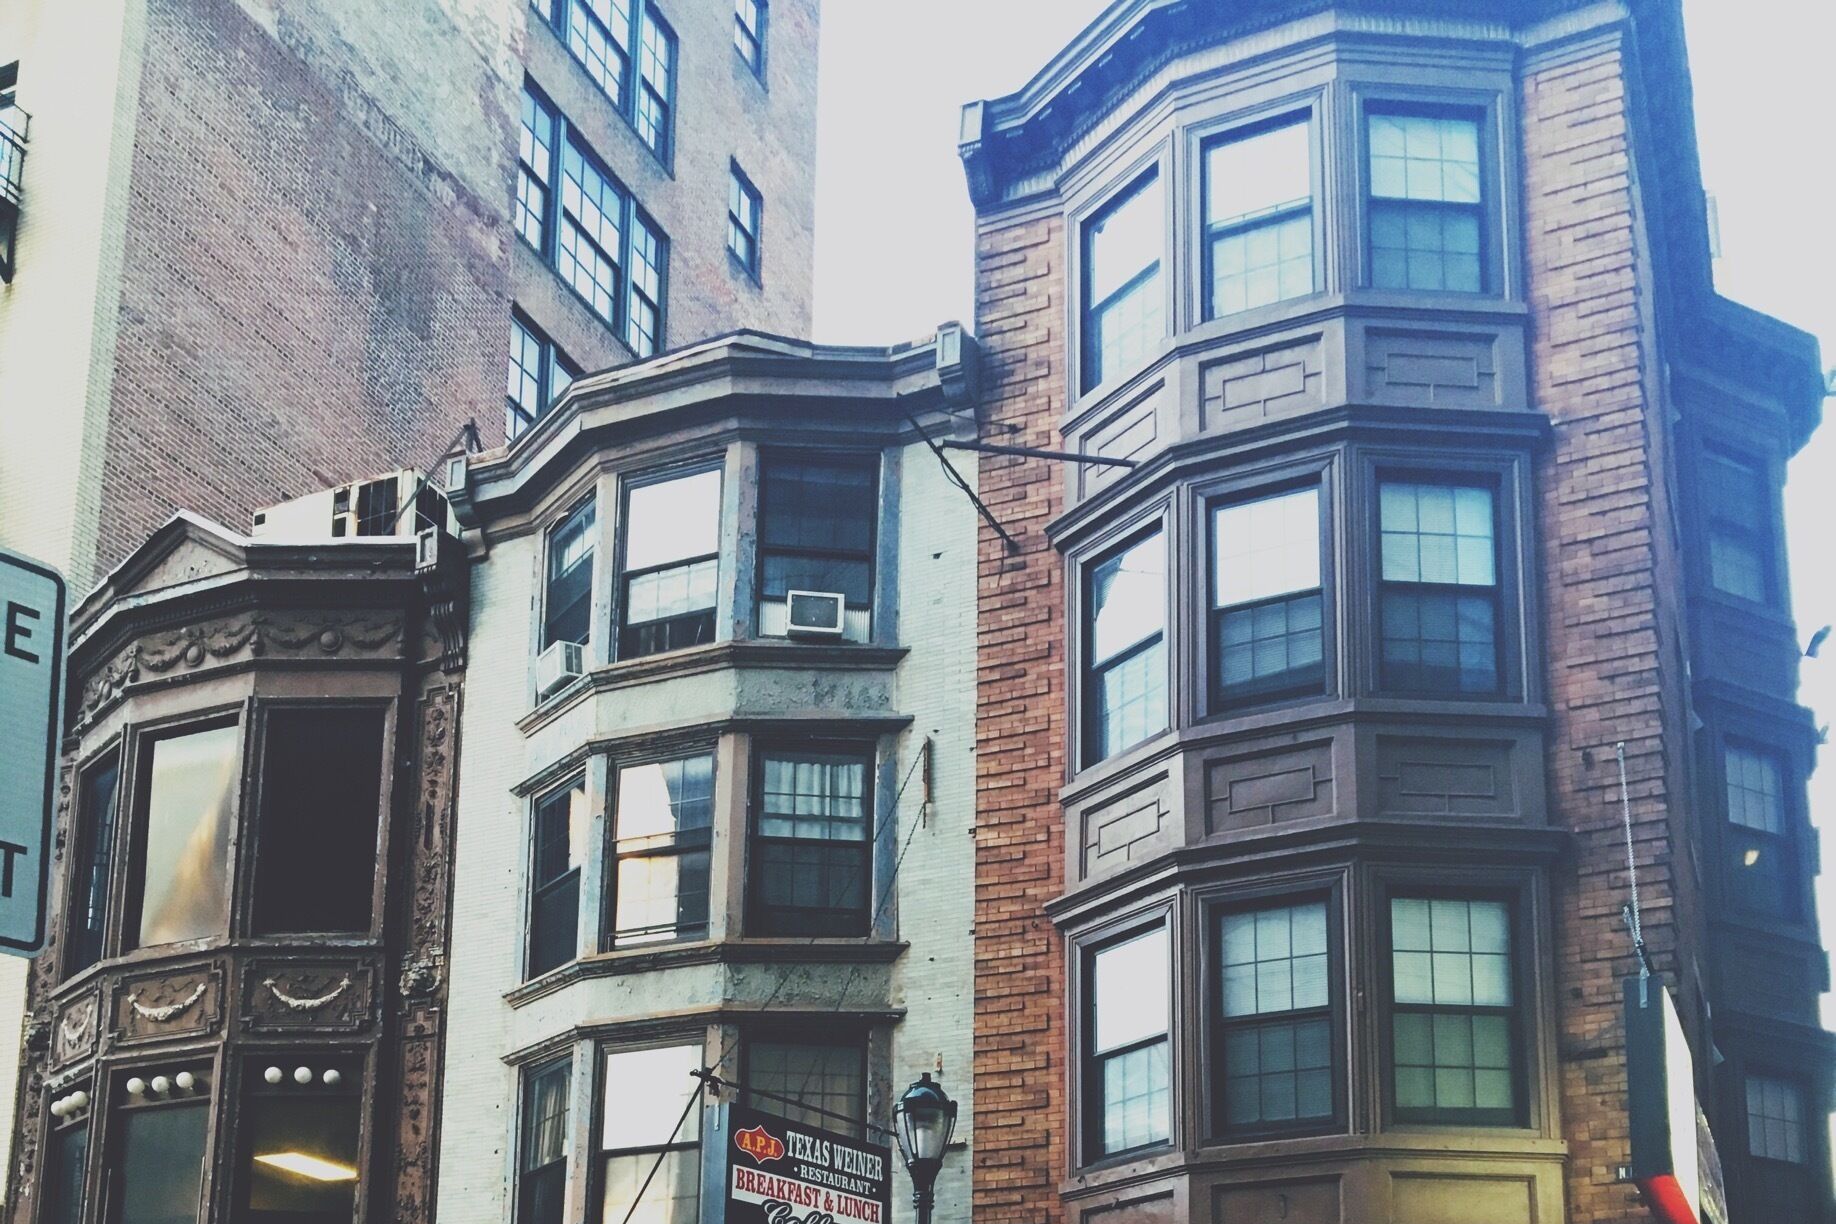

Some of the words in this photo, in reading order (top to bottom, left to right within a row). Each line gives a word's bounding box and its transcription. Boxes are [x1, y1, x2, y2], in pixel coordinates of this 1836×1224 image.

[742, 1133, 778, 1157] A.P.J.
[786, 1131, 830, 1167] TEXAS
[833, 1144, 883, 1181] WEINER
[801, 1165, 870, 1195] RESTAURANT
[736, 1168, 820, 1210] BREAKFAST
[823, 1191, 834, 1212] &
[837, 1195, 880, 1224] LUNCH
